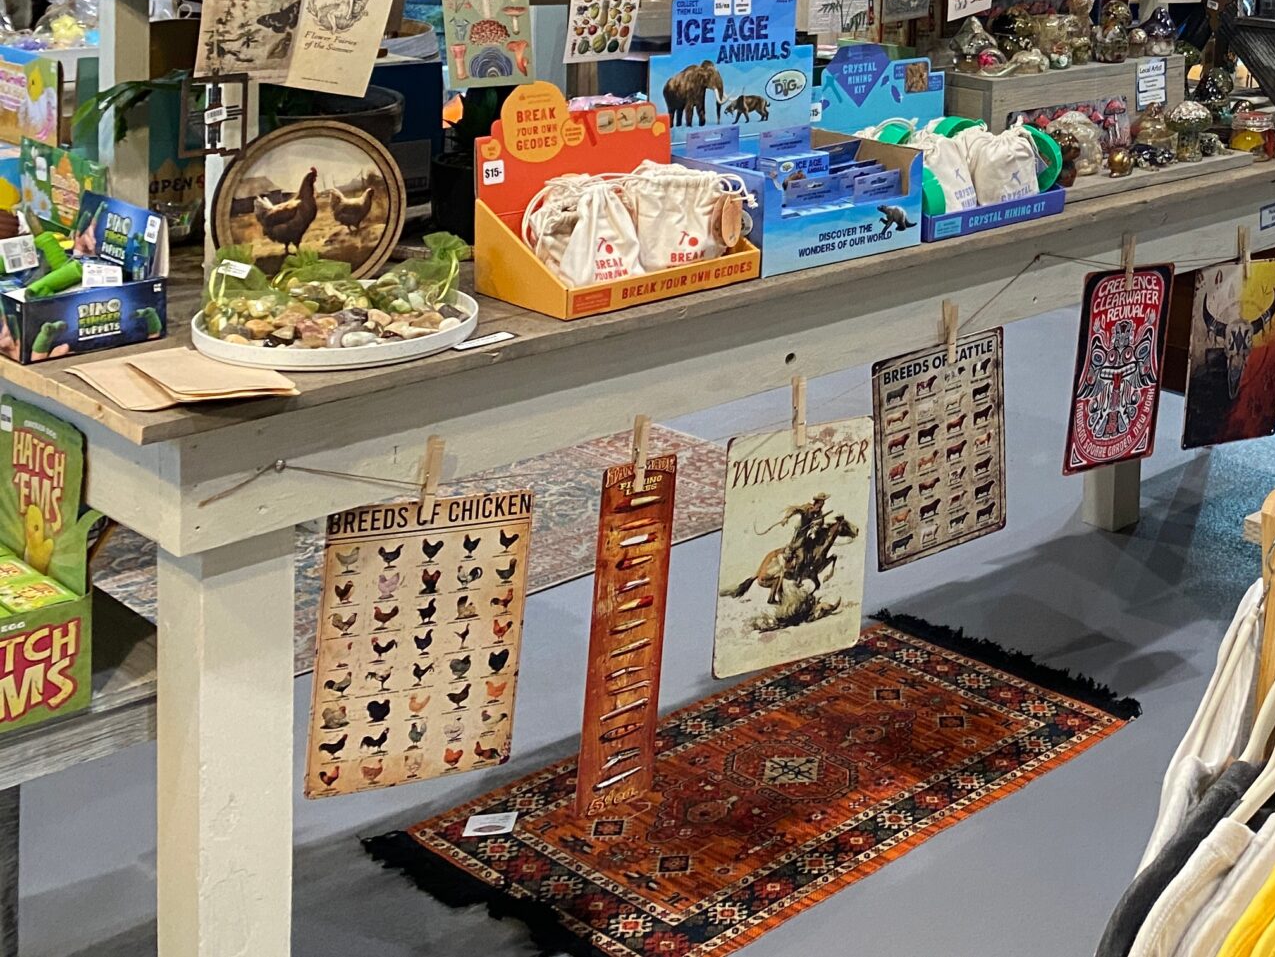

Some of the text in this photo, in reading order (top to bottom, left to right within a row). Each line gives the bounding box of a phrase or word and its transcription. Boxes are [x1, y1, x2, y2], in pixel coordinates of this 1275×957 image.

[304, 30, 331, 40] Flower
[676, 16, 769, 46] ICE AGE
[304, 40, 354, 53] of the Summer
[716, 40, 791, 64] ANIMALS
[842, 62, 877, 75] CRYSTAL
[847, 74, 873, 84] MINING
[854, 85, 865, 94] KIT
[516, 107, 556, 123] BREAK
[516, 124, 558, 136] YOUR OWN
[516, 136, 558, 151] GEODES
[795, 157, 822, 170] ICE AGE
[807, 164, 828, 174] ANIMALS
[485, 167, 502, 179] $15-
[149, 177, 192, 194] OPEN
[106, 212, 132, 234] DINO
[968, 201, 1046, 228] CRYSTAL MINING KIT
[818, 223, 873, 243] DISCOVER THE
[101, 242, 125, 260] PUPPETS
[798, 230, 893, 258] WONDERS OF OUR WORLD
[670, 251, 705, 263] BREAK
[621, 261, 753, 300] BREAK YOUR OWN GEODES
[1098, 275, 1159, 297] CREEENCE
[77, 298, 122, 319] DINO
[1093, 290, 1159, 313] CLEARWATER
[78, 312, 121, 327] FINGER
[1106, 304, 1145, 322] REVIVAL
[78, 322, 121, 336] PUPPETS
[883, 340, 993, 384] BREEDS OF ATTLE
[1132, 388, 1155, 435] NEW YORK
[1075, 401, 1088, 443] MADISON
[1082, 434, 1133, 458] SQUARE GARDEN
[12, 430, 66, 488] HATCH
[731, 438, 869, 489] WINCHESTER
[619, 475, 663, 490] FIING
[13, 471, 62, 533] 'EMS
[328, 507, 408, 535] BREEDS
[448, 493, 532, 522] CHICKEN
[0, 620, 26, 633] EGG
